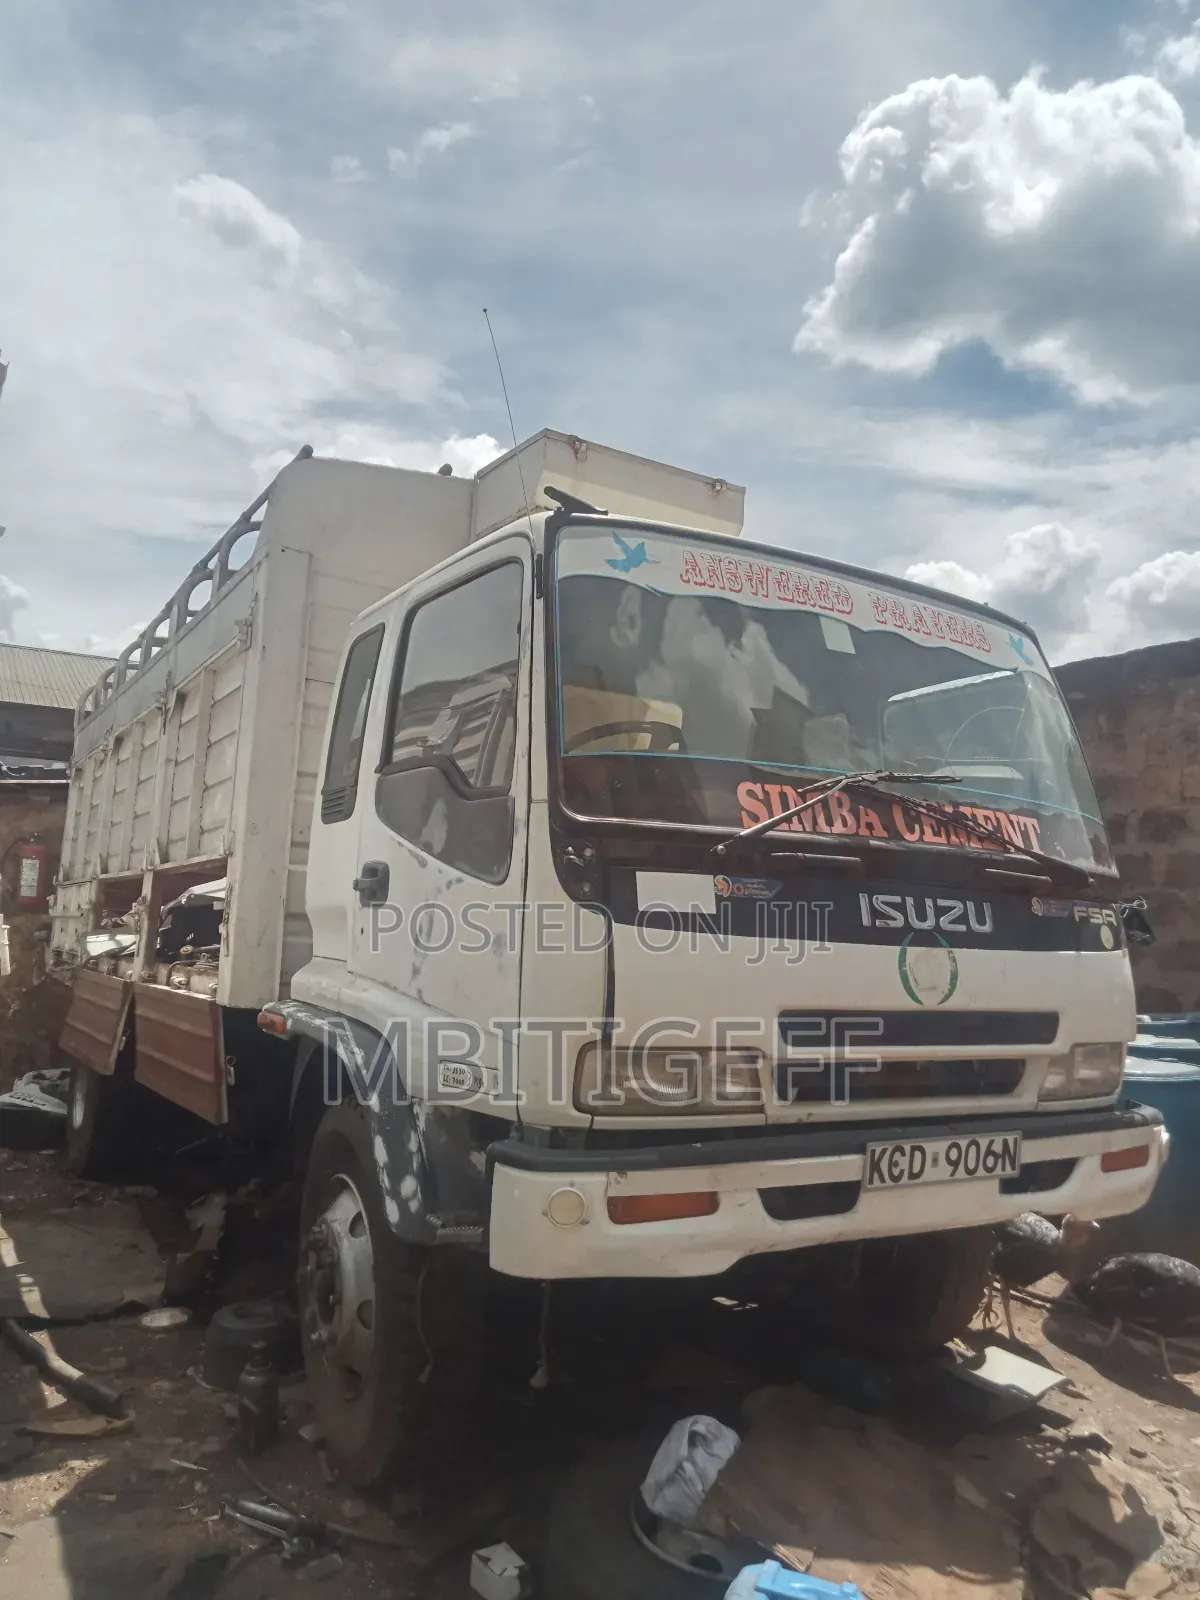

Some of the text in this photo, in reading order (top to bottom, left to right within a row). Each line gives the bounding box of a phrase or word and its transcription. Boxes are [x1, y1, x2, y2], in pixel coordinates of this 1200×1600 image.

[680, 550, 992, 653] ANSWERED PRAYERS
[736, 781, 1044, 854] SIMBA CEMENT
[858, 892, 994, 933] ISUZU
[1073, 906, 1118, 926] FSR
[867, 1136, 1019, 1186] KCD 906N
